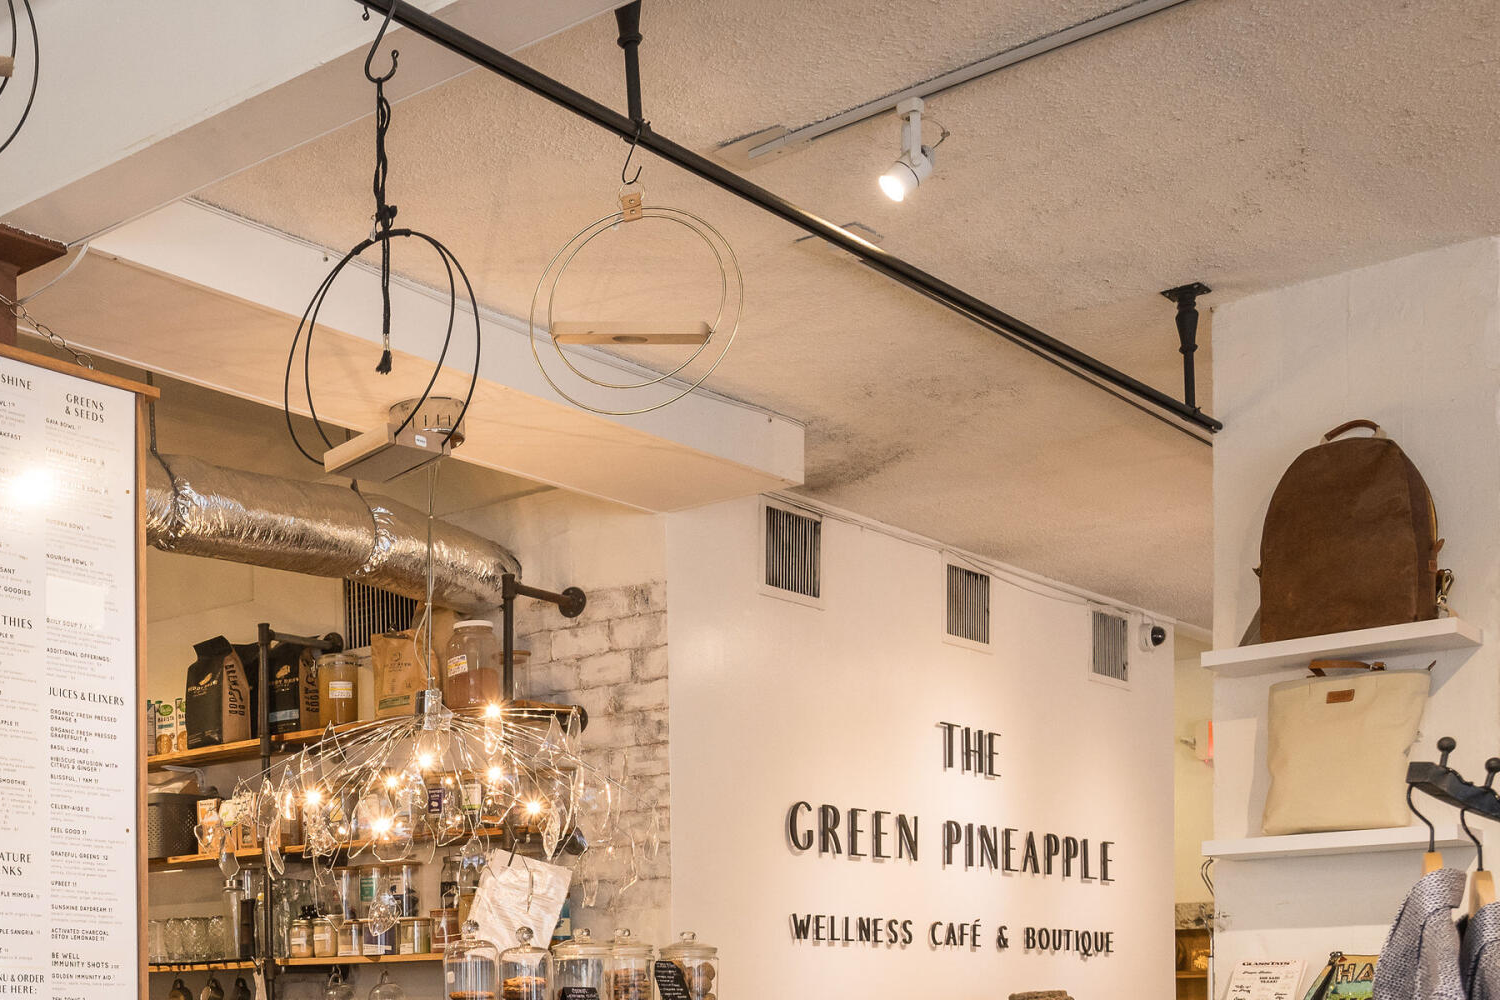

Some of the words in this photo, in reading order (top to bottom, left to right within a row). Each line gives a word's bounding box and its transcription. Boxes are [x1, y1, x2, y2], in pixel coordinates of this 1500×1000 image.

[0, 372, 32, 390] SHINE
[66, 393, 104, 411] GREENS
[65, 406, 70, 414] &
[74, 408, 104, 424] SEEDS
[4, 586, 31, 596] GOODIES
[50, 686, 78, 700] JUICES
[80, 688, 86, 700] &
[88, 690, 124, 706] ELIXERS
[940, 721, 1001, 777] THE
[789, 801, 918, 862] GREEN
[946, 820, 1115, 882] PINEAPPLE
[792, 913, 913, 944] WELLNESS
[930, 918, 982, 948] CAFÉ
[997, 925, 1008, 948] &
[1026, 926, 1114, 956] BOUTIQUE
[10, 974, 16, 982] &
[18, 974, 44, 984] ORDER
[10, 985, 38, 994] HERE:
